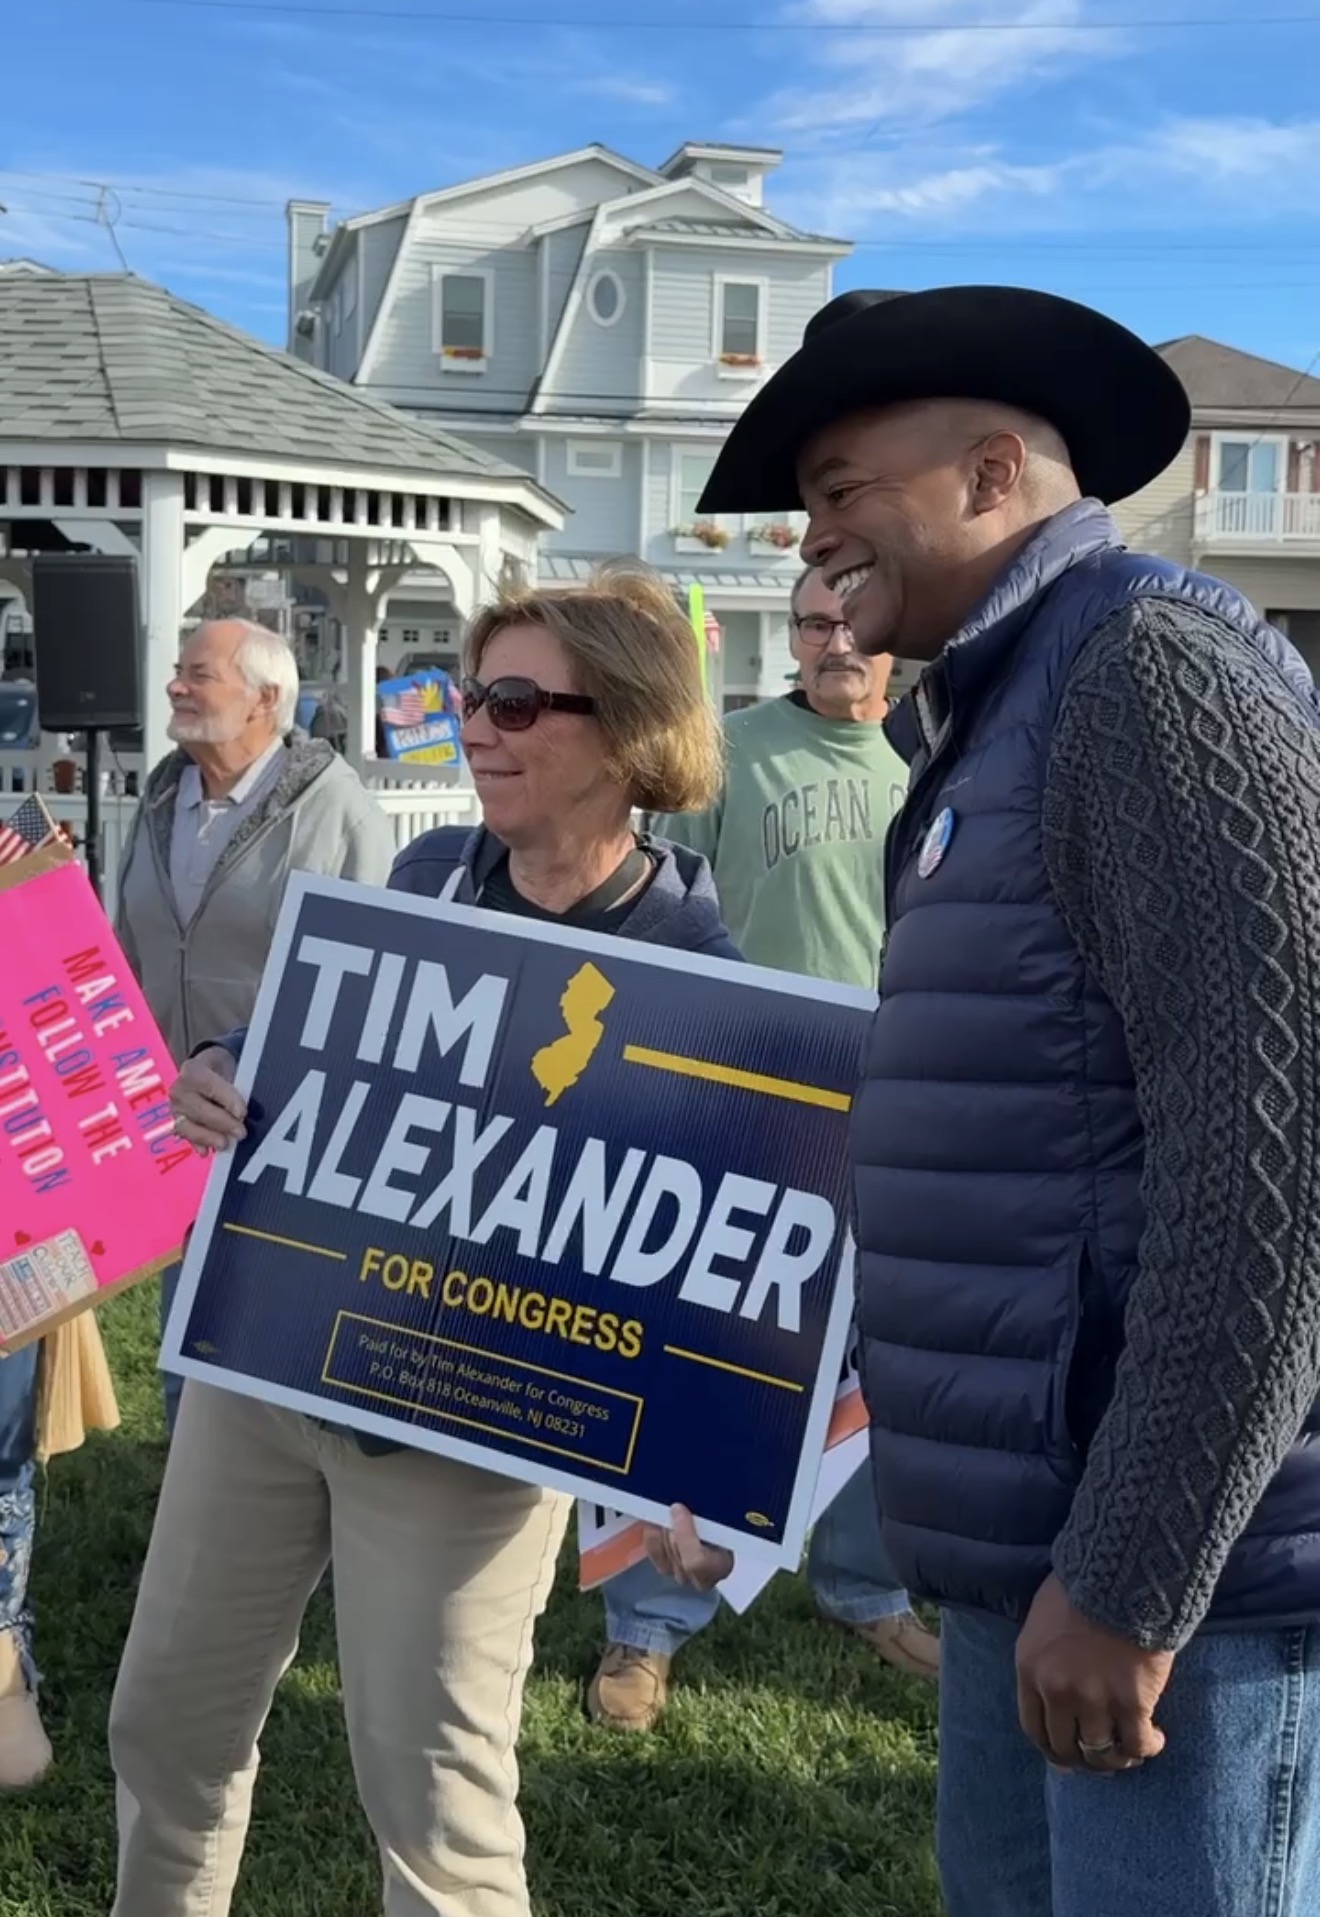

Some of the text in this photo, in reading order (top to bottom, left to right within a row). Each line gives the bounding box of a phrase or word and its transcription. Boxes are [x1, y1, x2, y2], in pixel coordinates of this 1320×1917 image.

[763, 778, 873, 869] OCEAN
[22, 985, 133, 1166] FOLLOW THE
[62, 946, 194, 1176] MAKE AMERICA
[297, 935, 509, 1088] TIM
[238, 1069, 836, 1333] ALEXANDER
[359, 1247, 644, 1358] FOR CONGRESS
[359, 1334, 610, 1421] Paid for by Tim Alexander for Congress
[370, 1361, 586, 1438] P.O. Box 818 Oceanville, NJ 08231
